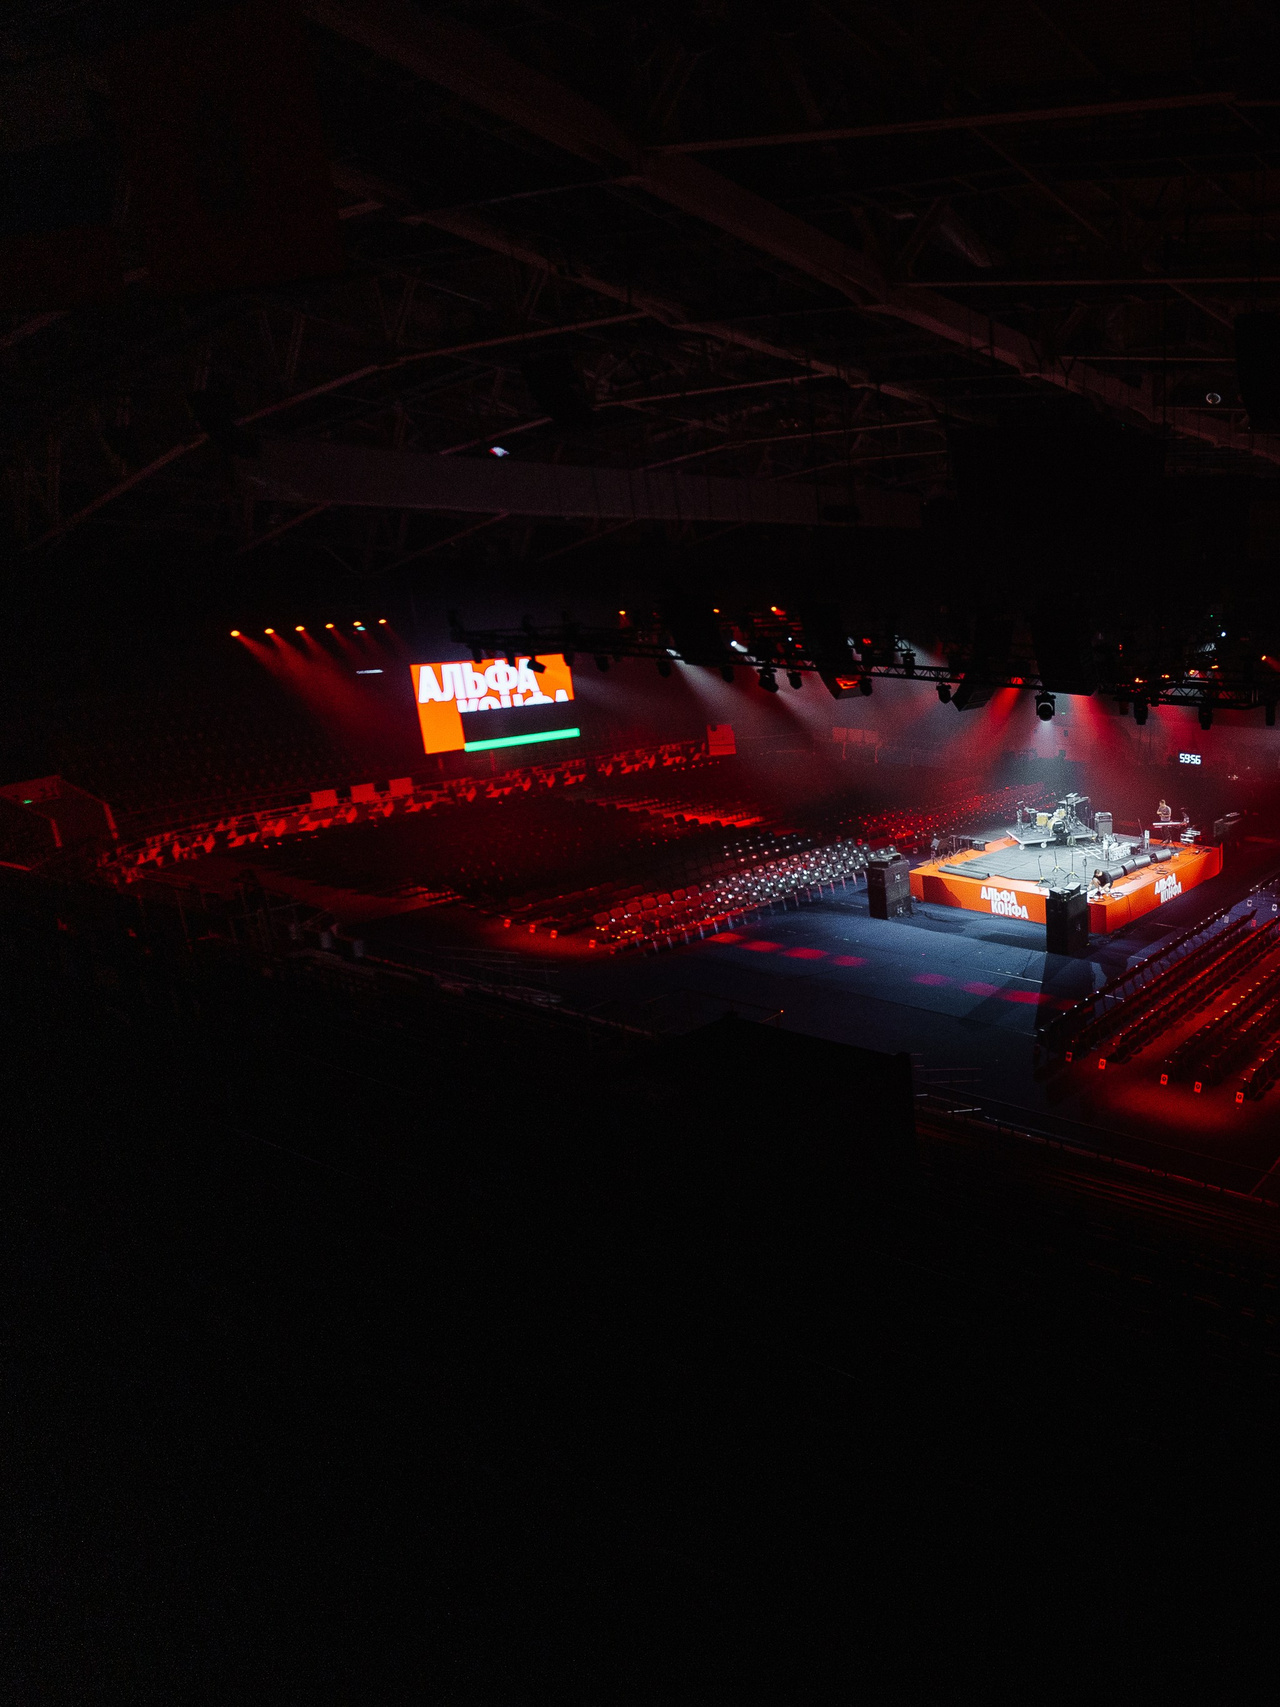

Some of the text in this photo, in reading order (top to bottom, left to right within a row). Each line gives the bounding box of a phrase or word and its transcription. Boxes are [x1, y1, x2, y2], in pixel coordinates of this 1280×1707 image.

[418, 658, 540, 703] АЛЬФА
[1179, 753, 1201, 765] 59:56
[1154, 873, 1177, 895] АЛЬФА
[1160, 881, 1182, 903] КОНФА
[980, 886, 1018, 905] АЛЬФА
[991, 899, 1029, 919] КОНФА
